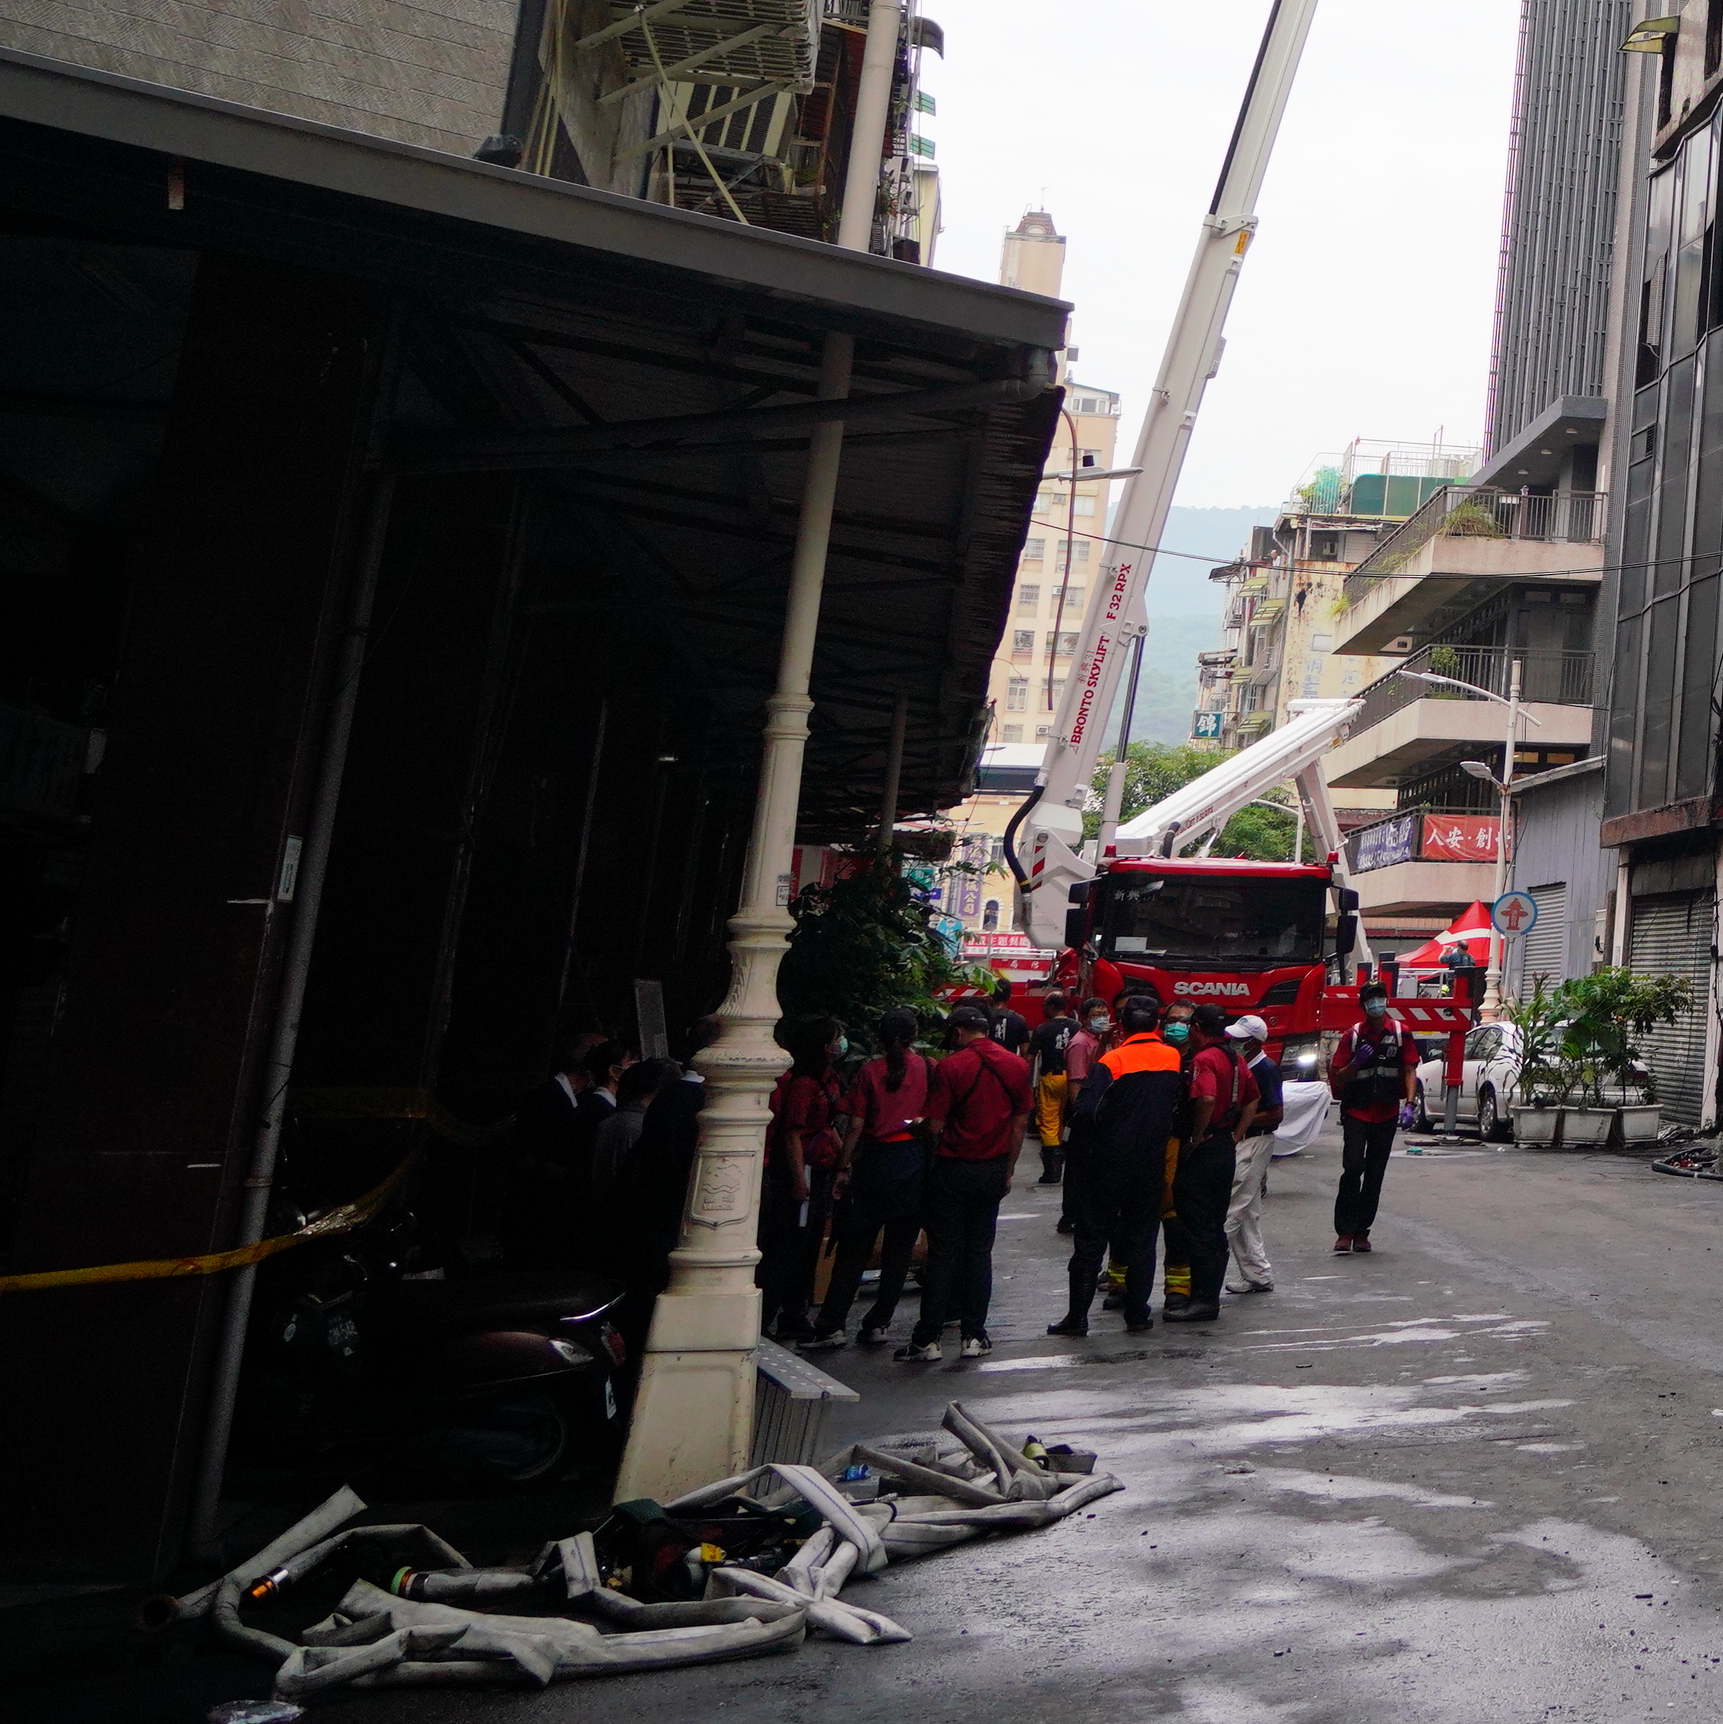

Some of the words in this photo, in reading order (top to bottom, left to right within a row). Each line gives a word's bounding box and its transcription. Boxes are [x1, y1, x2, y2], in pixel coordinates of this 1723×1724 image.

[1115, 563, 1131, 592] RPX
[1109, 594, 1122, 610] 32
[1106, 612, 1116, 620] F
[1071, 690, 1094, 743] BRONTO
[1087, 636, 1110, 688] SKYLIFT
[1174, 982, 1250, 996] SCANIA
